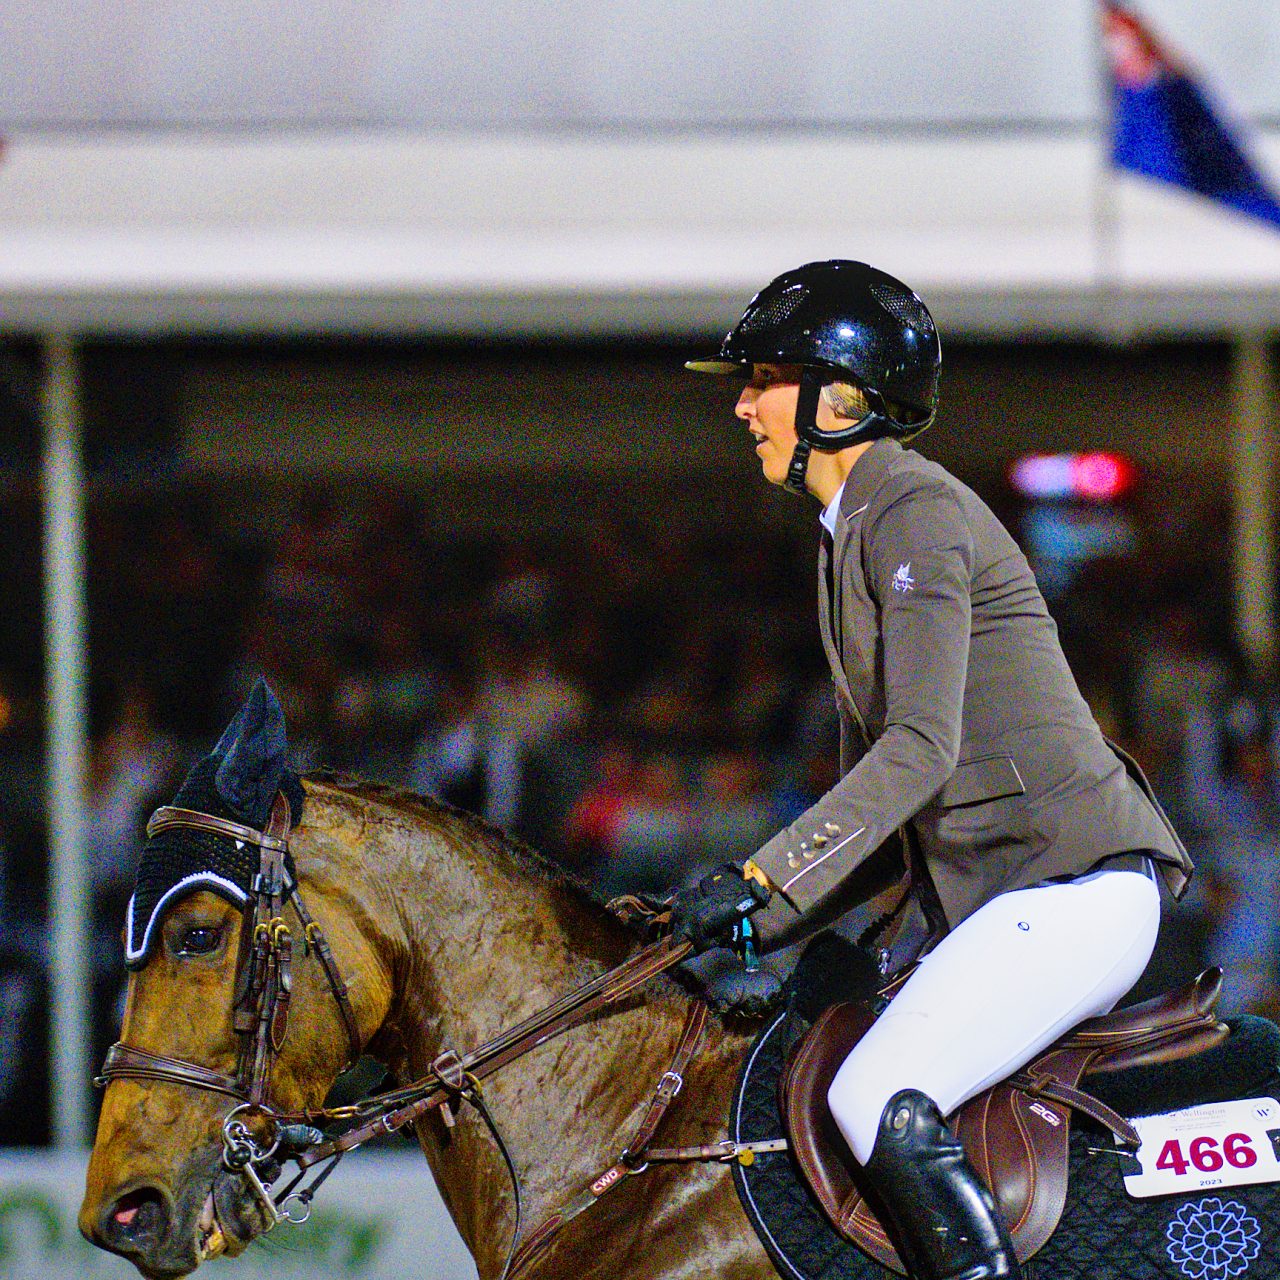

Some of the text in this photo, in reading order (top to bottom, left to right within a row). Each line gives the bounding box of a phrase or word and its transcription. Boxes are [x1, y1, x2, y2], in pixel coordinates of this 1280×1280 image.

[1155, 1132, 1258, 1175] 466
[593, 1170, 618, 1191] CWD
[1199, 1178, 1223, 1187] 2023
